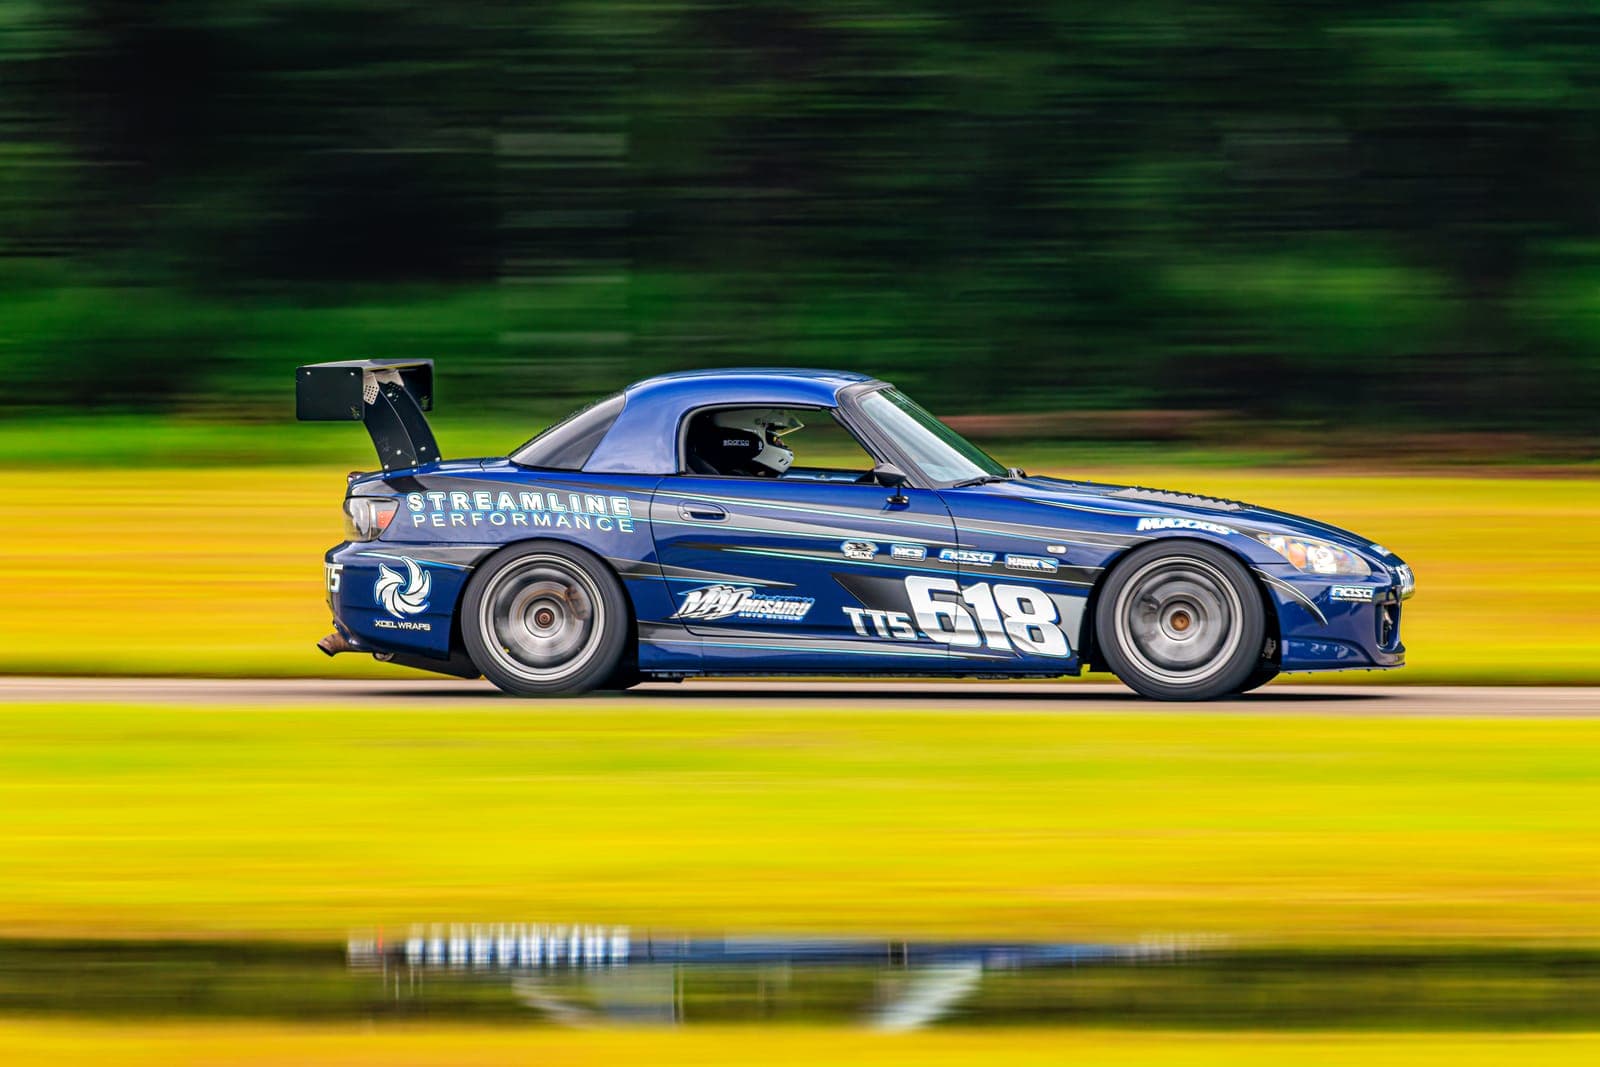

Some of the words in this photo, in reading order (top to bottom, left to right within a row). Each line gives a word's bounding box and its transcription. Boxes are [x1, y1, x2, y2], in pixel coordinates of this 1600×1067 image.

[407, 491, 632, 518] STREAMLINE
[413, 513, 634, 533] PERFORMANCE
[672, 585, 756, 619] MAD
[375, 620, 398, 629] XCEL
[398, 621, 432, 631] WRAPS
[905, 575, 1072, 658] 618
